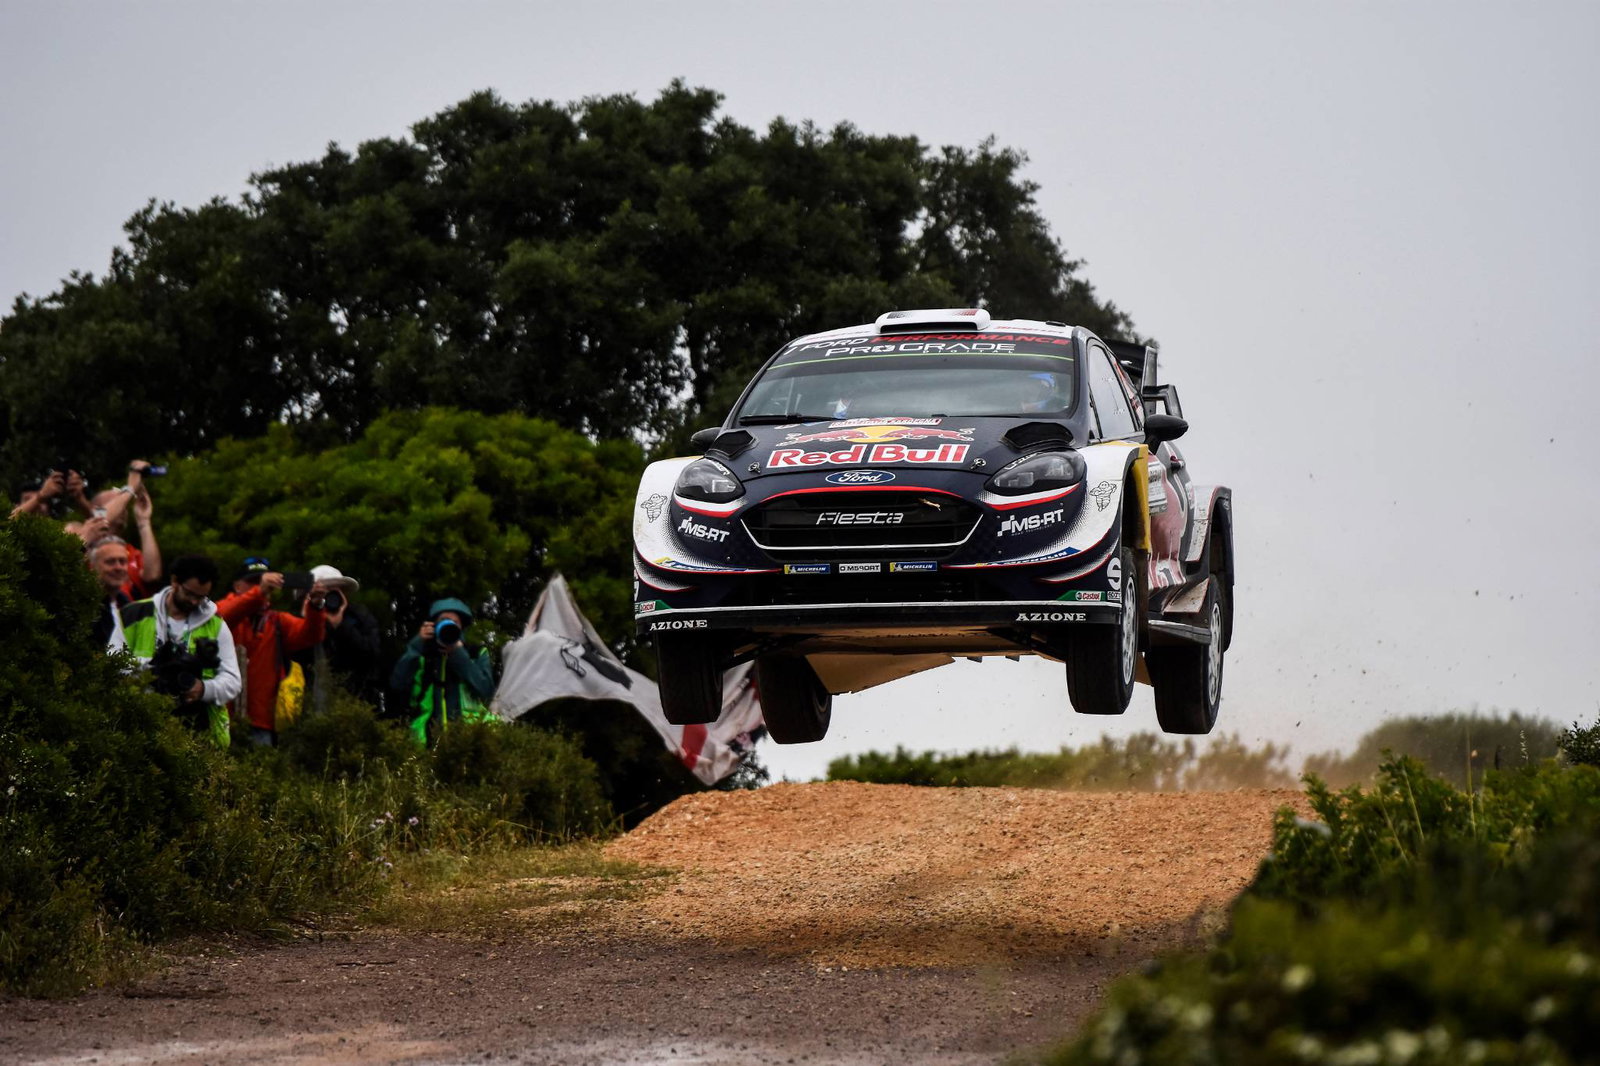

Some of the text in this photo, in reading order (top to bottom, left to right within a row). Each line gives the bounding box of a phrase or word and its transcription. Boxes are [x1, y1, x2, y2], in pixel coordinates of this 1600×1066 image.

[799, 338, 869, 352] FORD
[768, 444, 969, 467] Red Bull
[838, 471, 881, 483] Ford
[816, 512, 904, 525] Fiesta
[1082, 592, 1100, 600] Castrol
[1016, 613, 1086, 622] AZIONE
[650, 620, 708, 631] AZIONE
